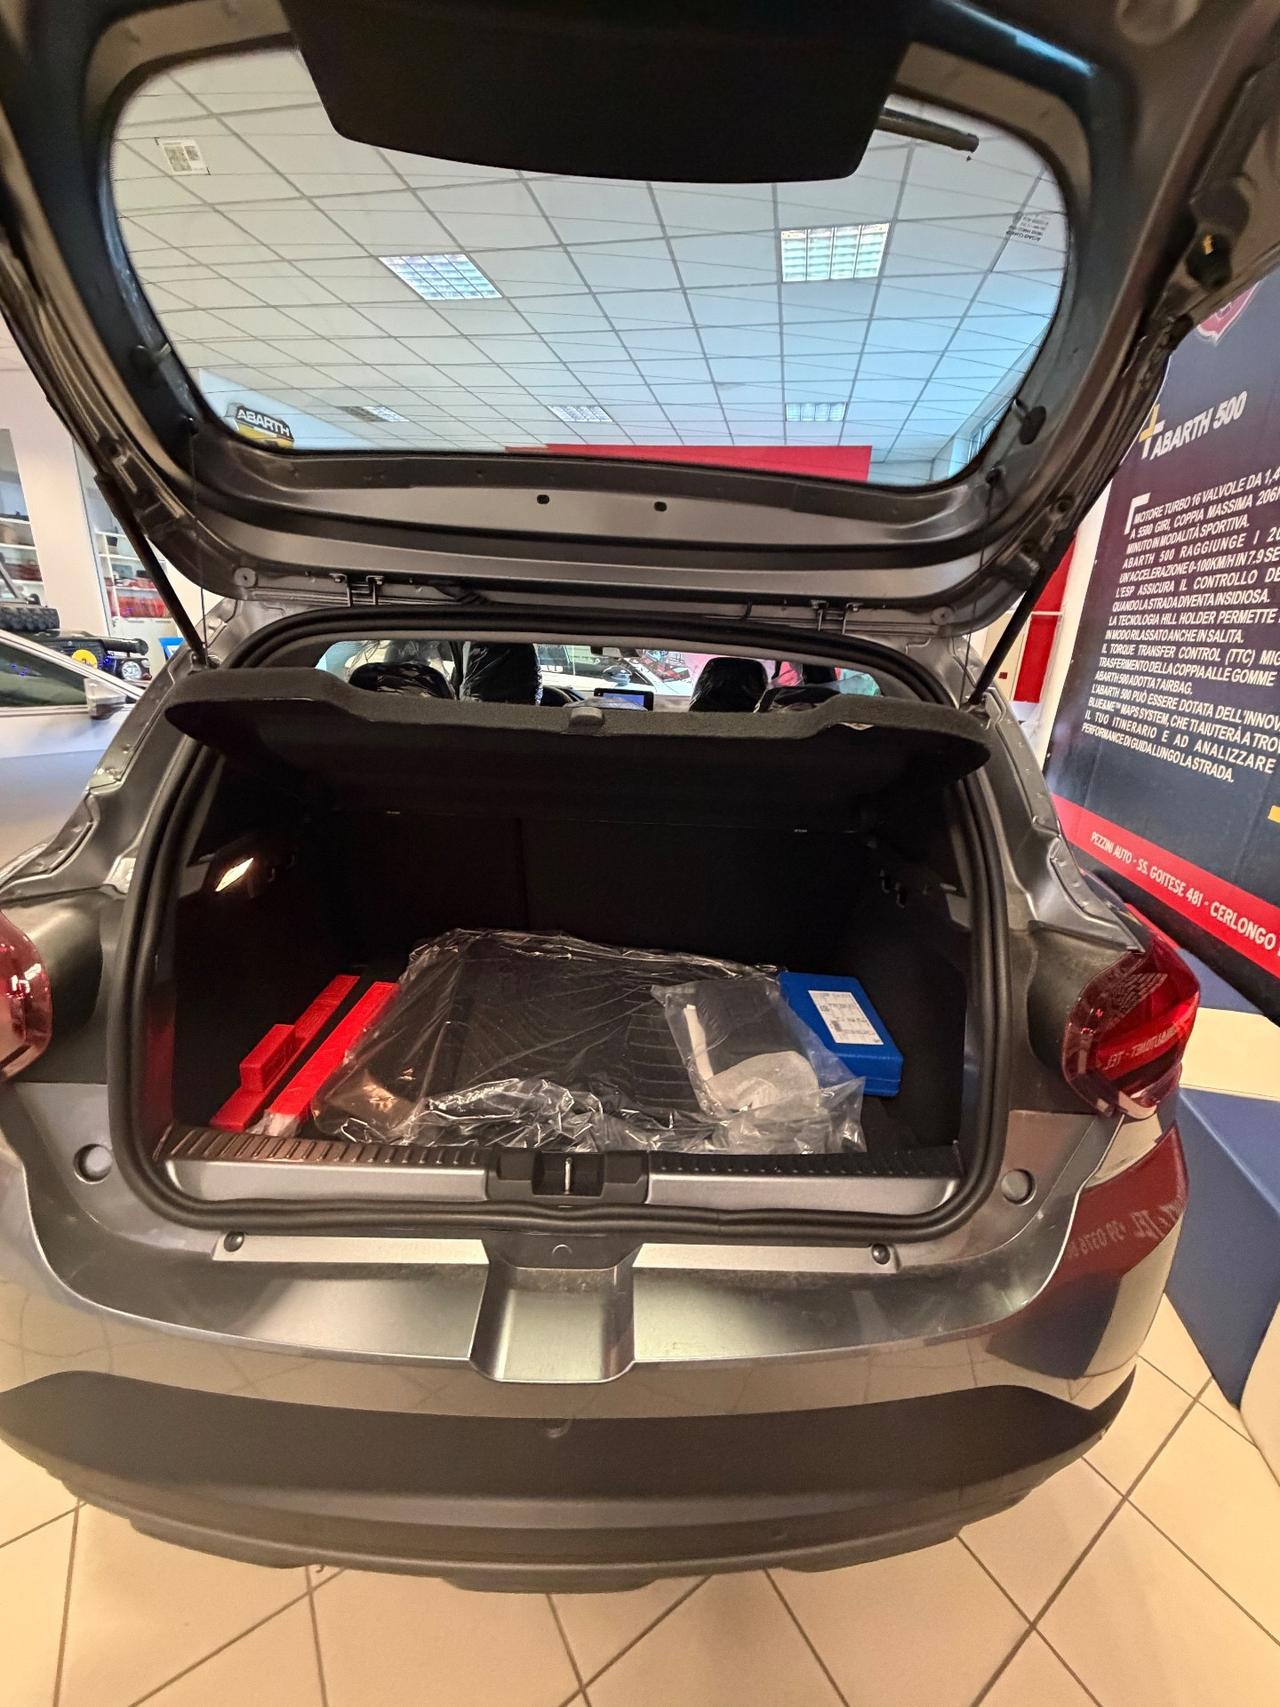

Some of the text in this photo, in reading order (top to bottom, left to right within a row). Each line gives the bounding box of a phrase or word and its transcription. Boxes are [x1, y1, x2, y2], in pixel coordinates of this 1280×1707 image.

[237, 409, 290, 436] ABARTH
[1150, 391, 1247, 460] ABARTH 500
[1133, 505, 1164, 525] MOTORE
[1164, 496, 1191, 515] TURBO
[1192, 493, 1202, 506] 16
[1203, 477, 1246, 504] VALVOLE
[1246, 472, 1262, 490] DA
[1129, 528, 1135, 540] A
[1137, 523, 1153, 538] 5500
[1155, 518, 1171, 531] GIRI,
[1174, 508, 1204, 528] COPPIA
[1206, 494, 1253, 519] MASSIMA
[1122, 552, 1155, 569] ABARTH
[1159, 548, 1175, 562] 500
[1179, 533, 1247, 558] RAGGIUNGE
[1253, 530, 1260, 544] I
[1126, 514, 1250, 555] MINUTO IN MODALITÀ SPORTIVA.
[1235, 551, 1248, 566] IN
[1112, 588, 1270, 612] QUANDO LA STRADA DIVENTA INSIDIOSA.
[1115, 586, 1136, 598] L'ESP
[1137, 580, 1174, 596] ASSICURA
[1179, 578, 1188, 592] IL
[1193, 570, 1258, 590] CONTROLLO
[1108, 608, 1278, 626] LA TECNOLOGIA HILL HOLDER PERMETTE
[1105, 629, 1244, 643] IN MODO RILASSATO ANCHE IN SALITA.
[1099, 657, 1278, 686] TRASFERIMENTO DELLA COPPIA ALLE GOMME
[1110, 644, 1136, 655] TORQUE
[1137, 644, 1176, 658] TRANSFER
[1178, 646, 1221, 662] CONTROL
[1225, 648, 1256, 667] (TTC)
[1094, 670, 1192, 695] ABARTH 500 ADOTTA 7 AIRBAG.
[1091, 684, 1120, 698] L'ABARTH
[1120, 688, 1132, 700] 500
[1131, 689, 1147, 703] PUÒ
[1147, 693, 1179, 710] ESSERE
[1178, 699, 1214, 718] DOTATA
[1084, 709, 1277, 774] IL TUO ITINERARIO E AD ANALIZZARE
[1120, 703, 1140, 718] MAPS
[1139, 708, 1170, 727] SYSTEM,
[1170, 714, 1190, 730] CHE
[1189, 719, 1199, 732] TI
[1197, 721, 1242, 744] AIUTERÀ
[1240, 731, 1251, 746] A
[1081, 722, 1234, 783] PERFORMANCE DI GUIDA LUNGO LA STRADA.
[1113, 845, 1132, 864] AUTO
[1150, 866, 1187, 897] GOITESE
[1186, 887, 1203, 907] 481
[1209, 901, 1276, 950] CERLONGO
